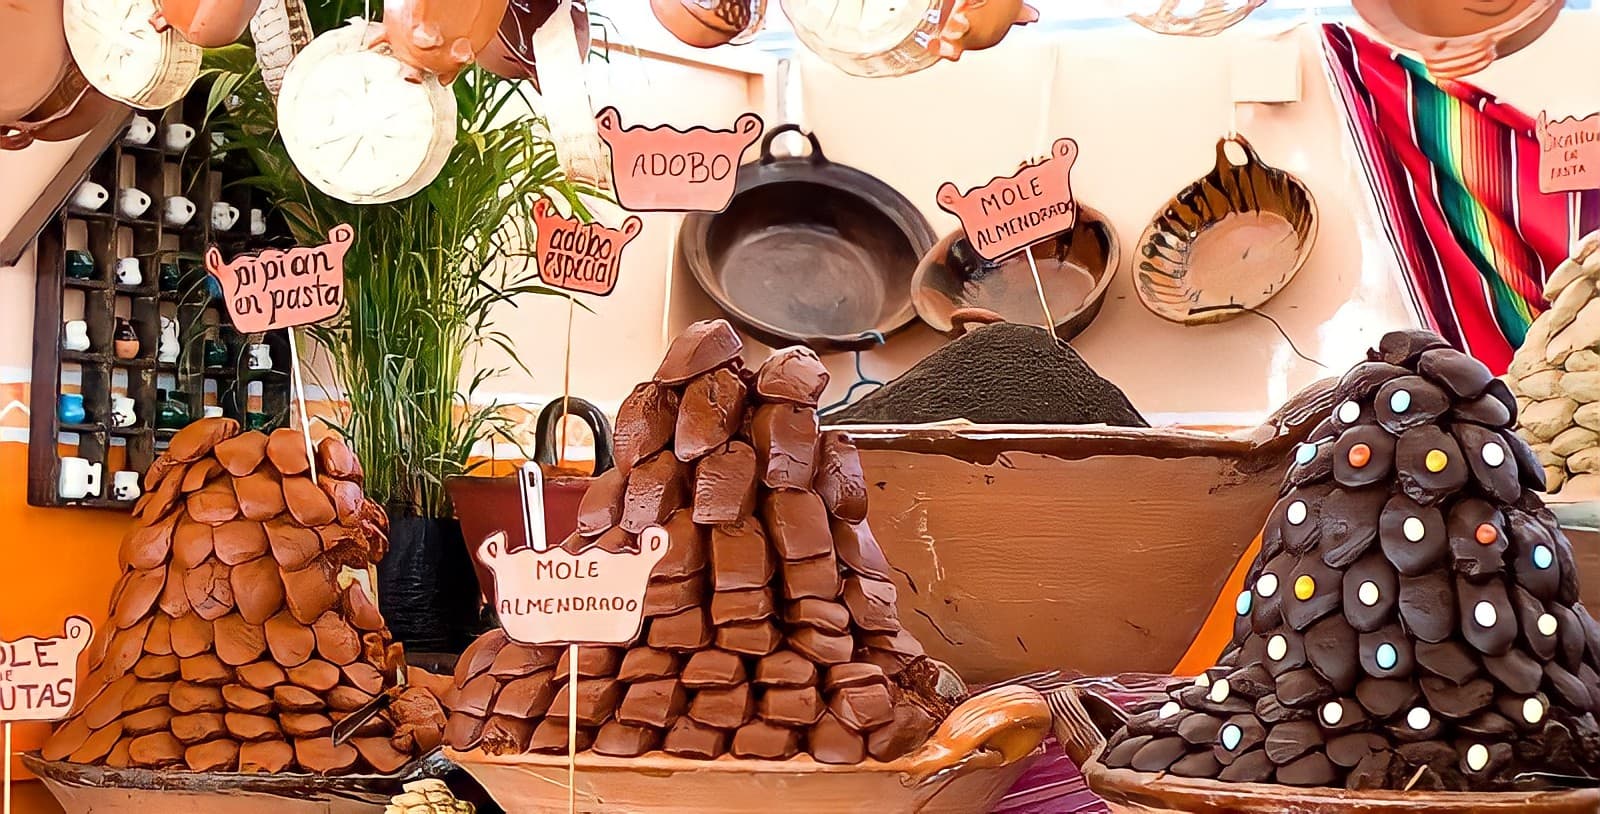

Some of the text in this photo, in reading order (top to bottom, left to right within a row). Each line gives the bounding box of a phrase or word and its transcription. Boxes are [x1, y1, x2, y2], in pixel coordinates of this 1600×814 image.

[631, 152, 732, 183] ADOBO
[980, 176, 1043, 216] MOLE
[976, 199, 1073, 250] ALMENDRADO
[550, 225, 612, 261] adobo
[234, 251, 335, 296] pipian
[543, 252, 617, 287] especial
[235, 274, 340, 325] en pasta
[536, 559, 599, 580] MOLE
[500, 596, 637, 616] ALMENDRADO
